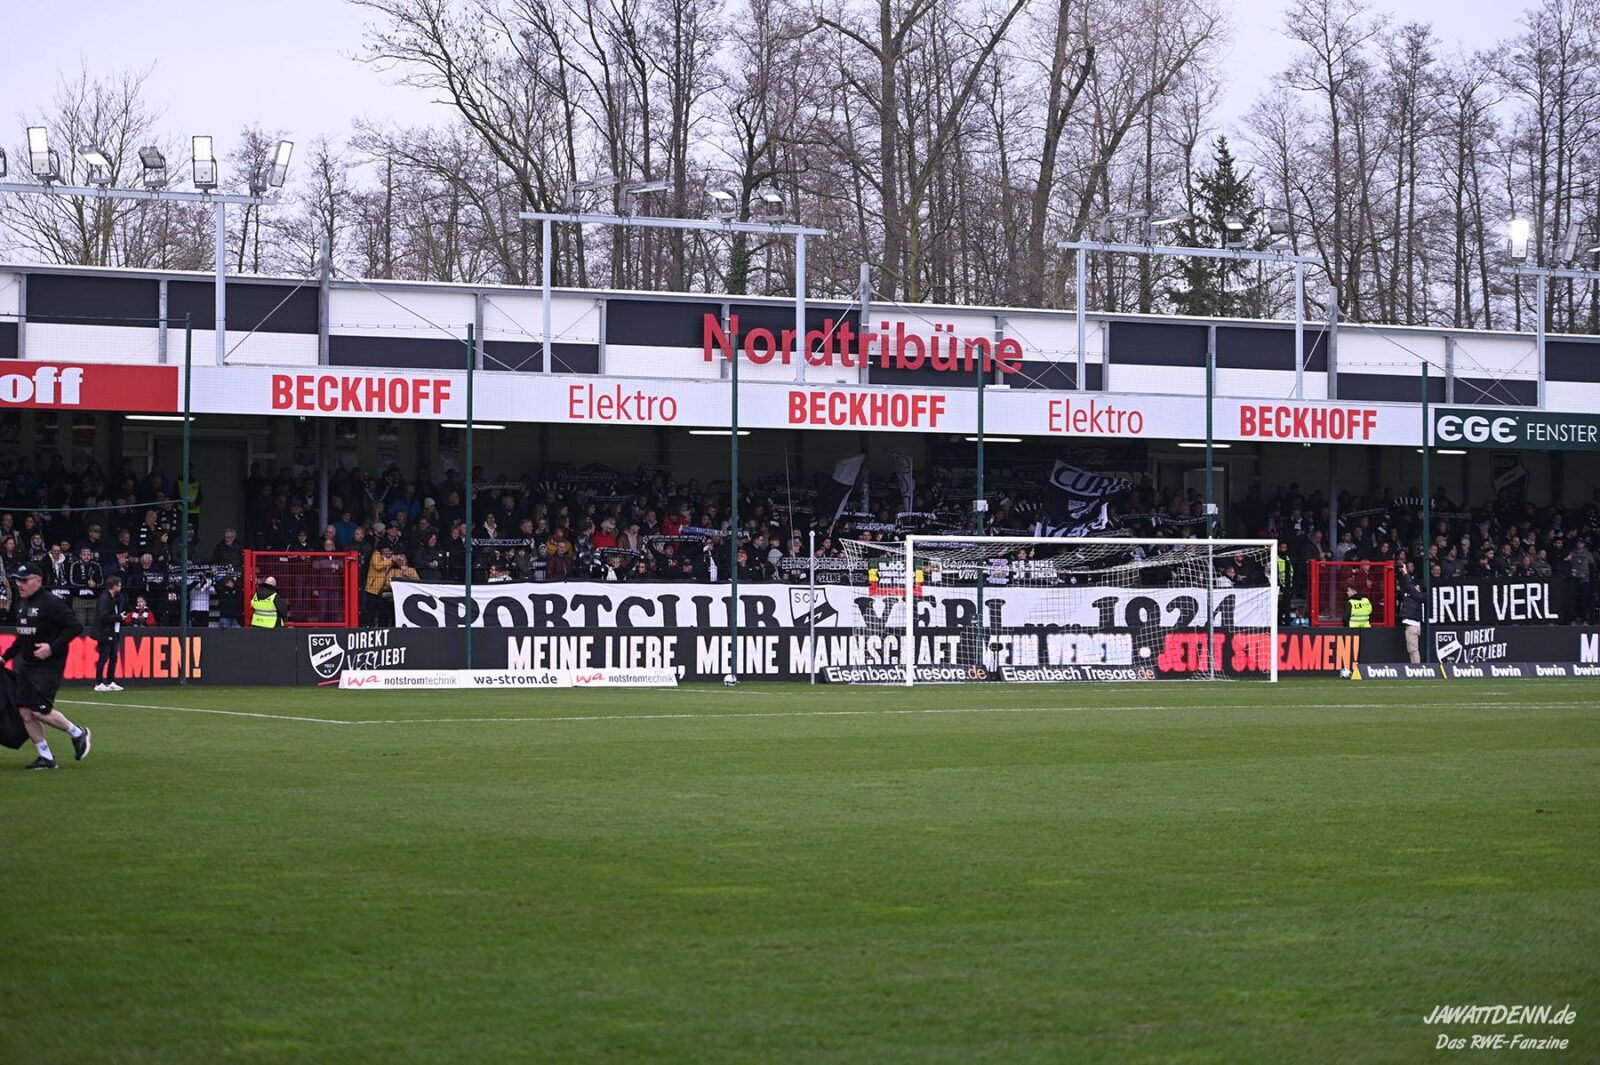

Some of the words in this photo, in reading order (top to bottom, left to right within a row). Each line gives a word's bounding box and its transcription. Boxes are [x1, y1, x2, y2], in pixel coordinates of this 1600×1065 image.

[703, 313, 1023, 375] Nordtribüne
[0, 366, 84, 405] off
[271, 374, 451, 414] BECKHOFF
[568, 383, 678, 422] Elektro
[787, 391, 946, 428] BECKHOFF
[1048, 400, 1143, 434] Elektro
[1240, 405, 1377, 440] BECKHOFF
[1437, 415, 1518, 443] EGE
[1526, 423, 1597, 443] FENSTER
[1492, 582, 1559, 621] VERL
[312, 638, 331, 646] SCV
[347, 628, 390, 651] DIREKT
[1438, 634, 1454, 642] SCV
[1464, 627, 1496, 646] DIREKT
[346, 646, 407, 671] VERLIEBT
[507, 635, 594, 669] MEINE
[696, 635, 779, 674] MEINE
[789, 635, 961, 674] MANNSCHAFT
[384, 675, 457, 686] notstromtechnik
[473, 673, 558, 685] wa-strom.de
[608, 672, 674, 684] notstromtechnik
[827, 666, 907, 683] Eisenbach
[1002, 666, 1081, 682] Eisenbach
[1082, 666, 1156, 681] Tresore.de
[1367, 664, 1398, 678] bwin
[1404, 664, 1435, 678] bwin
[1452, 664, 1484, 678] bwin
[1491, 664, 1522, 678] bwin
[1535, 664, 1566, 678] bwin
